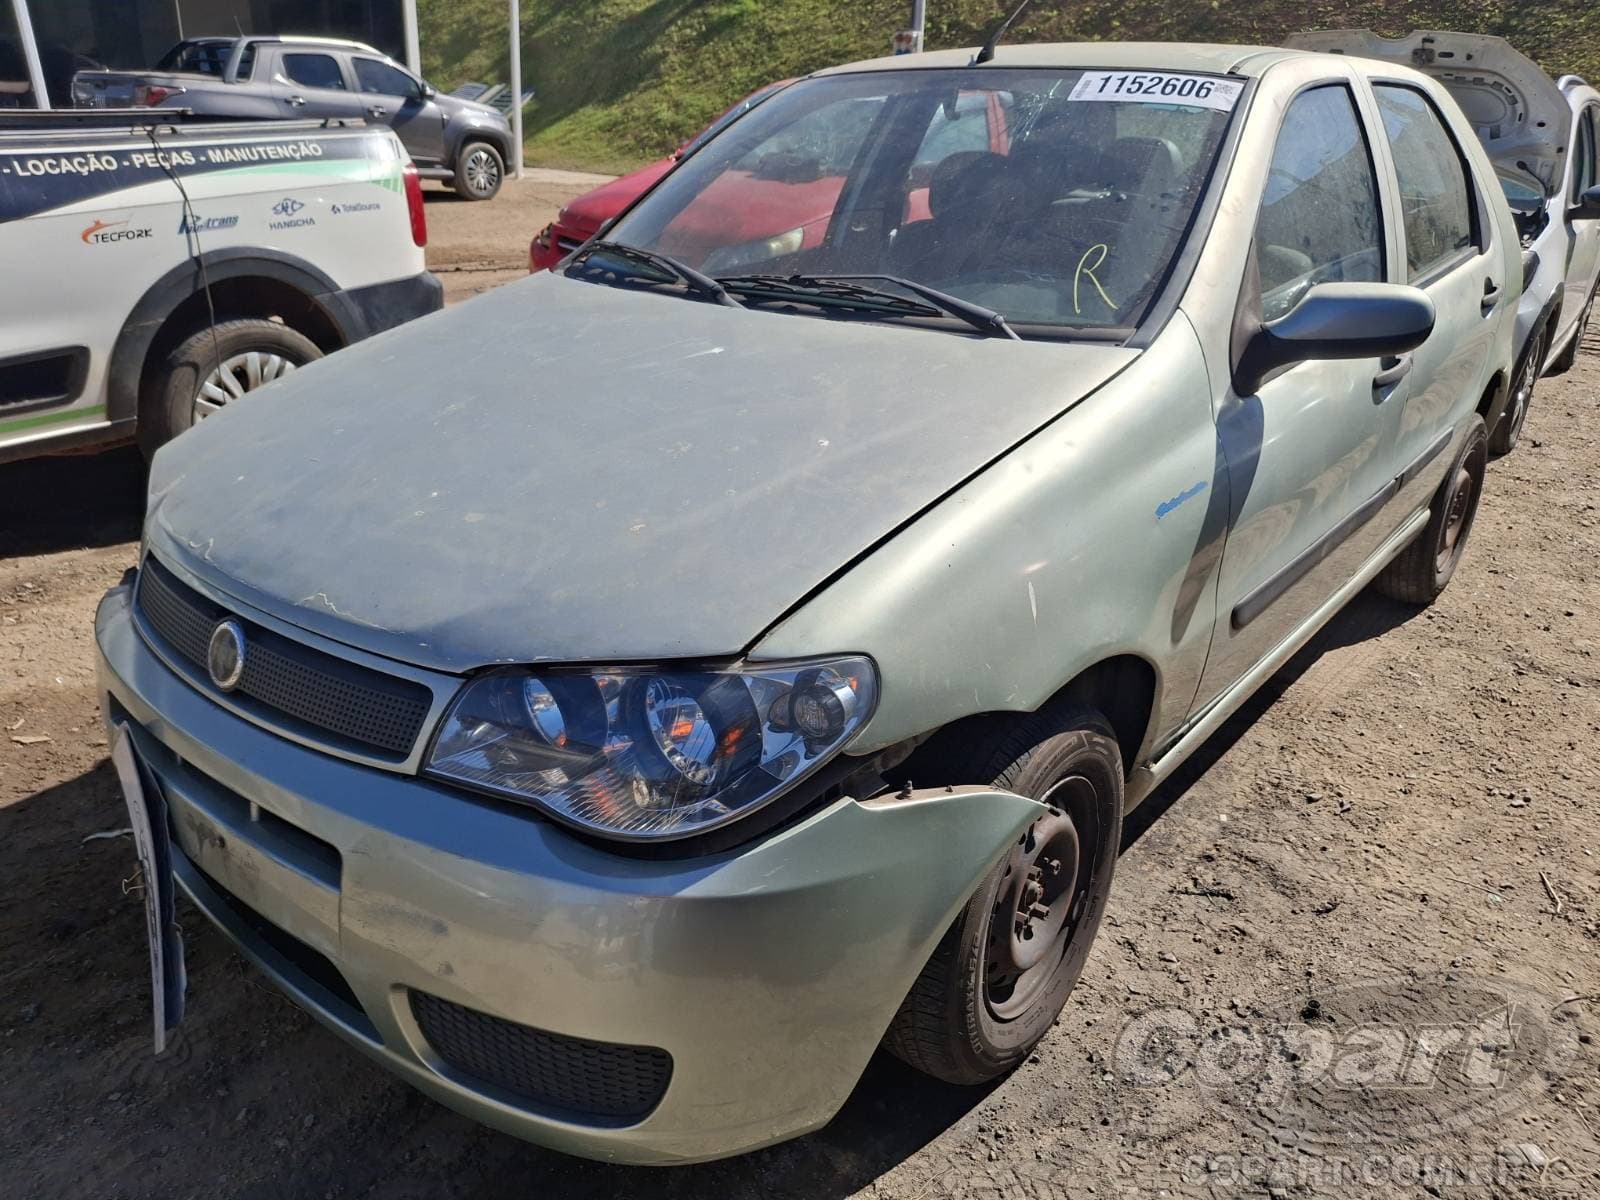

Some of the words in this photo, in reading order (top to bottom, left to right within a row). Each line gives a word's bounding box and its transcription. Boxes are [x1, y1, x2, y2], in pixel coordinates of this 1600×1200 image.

[1097, 75, 1215, 99] 1152606
[13, 153, 118, 176] LOCAÇÃO
[132, 151, 196, 169] PEÇAS
[207, 142, 322, 164] MANUTENÇÃO
[268, 217, 316, 230] HANGCHA
[94, 228, 152, 244] TECFORK
[1073, 243, 1119, 314] R
